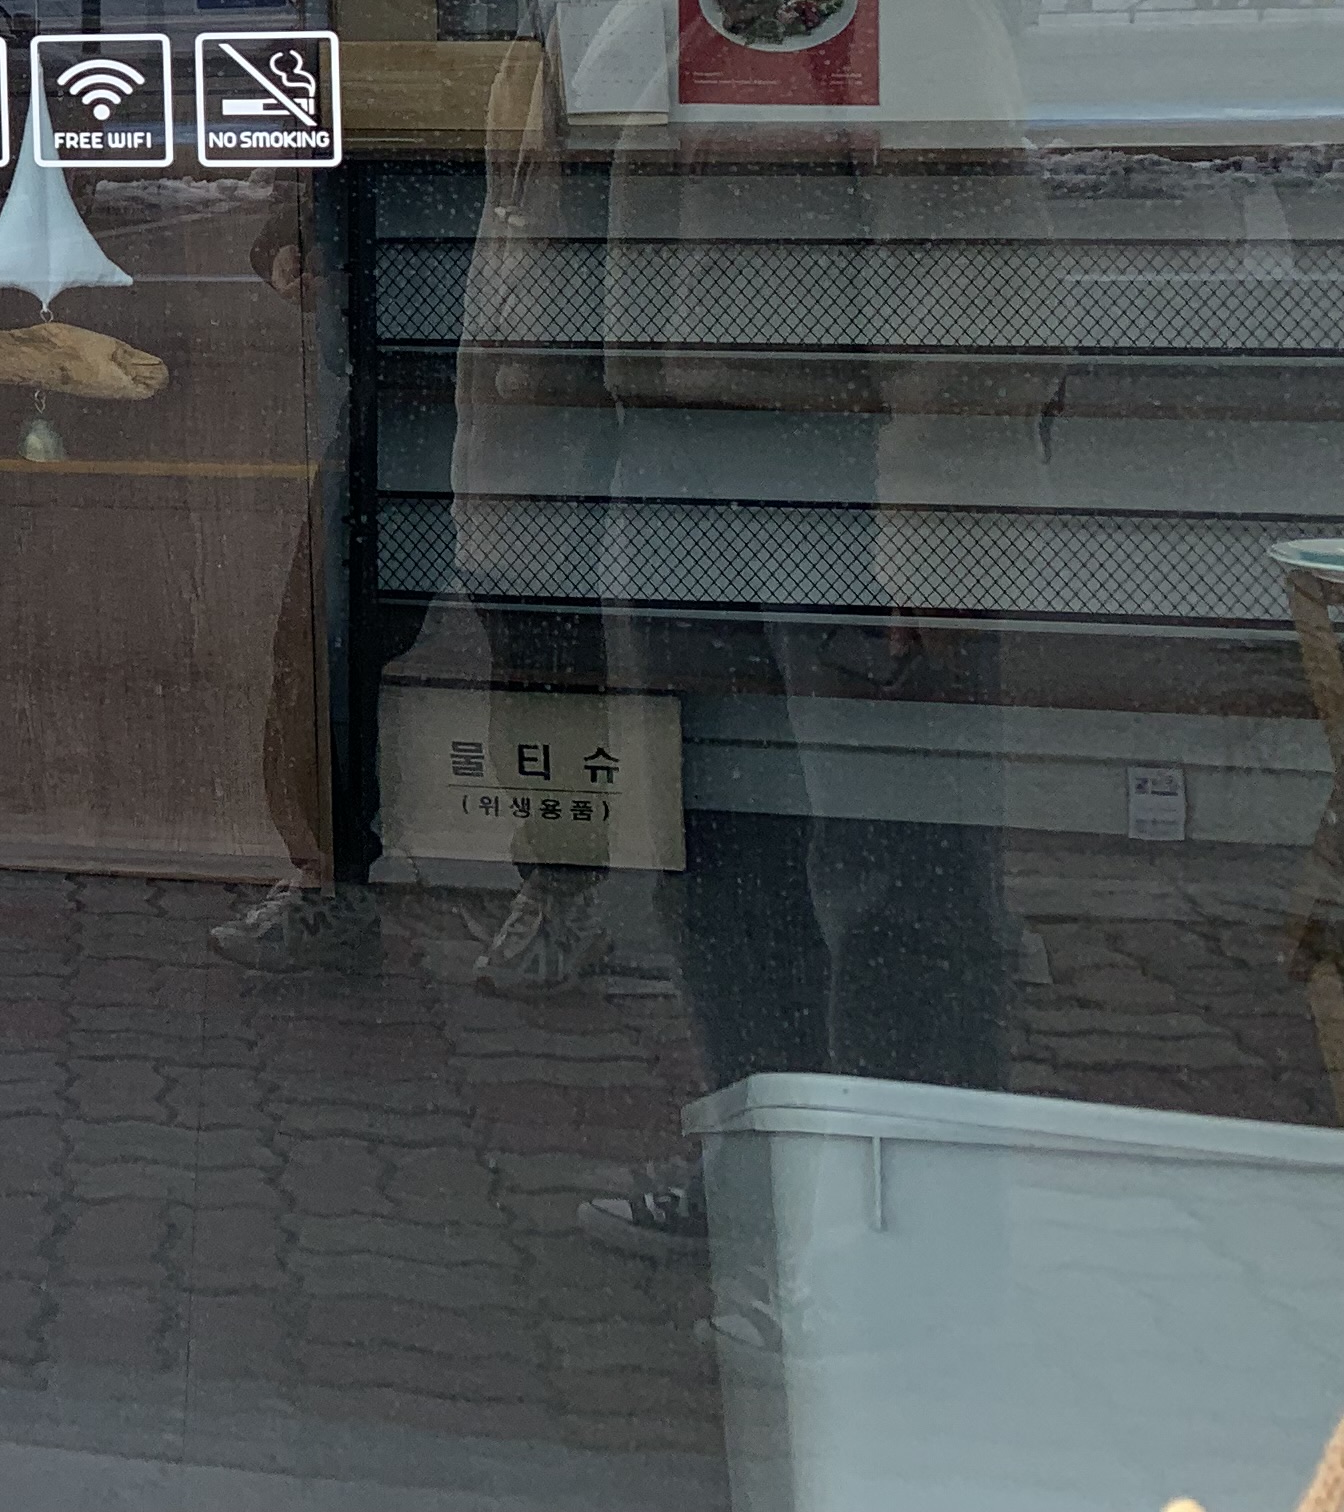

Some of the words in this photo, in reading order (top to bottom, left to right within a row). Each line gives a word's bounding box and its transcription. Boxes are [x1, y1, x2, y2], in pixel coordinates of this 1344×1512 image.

[53, 131, 105, 150] FREE
[109, 131, 152, 150] WIFI
[208, 131, 238, 150] NO
[240, 130, 330, 150] SMOKING
[462, 794, 611, 822] (위생용품)
